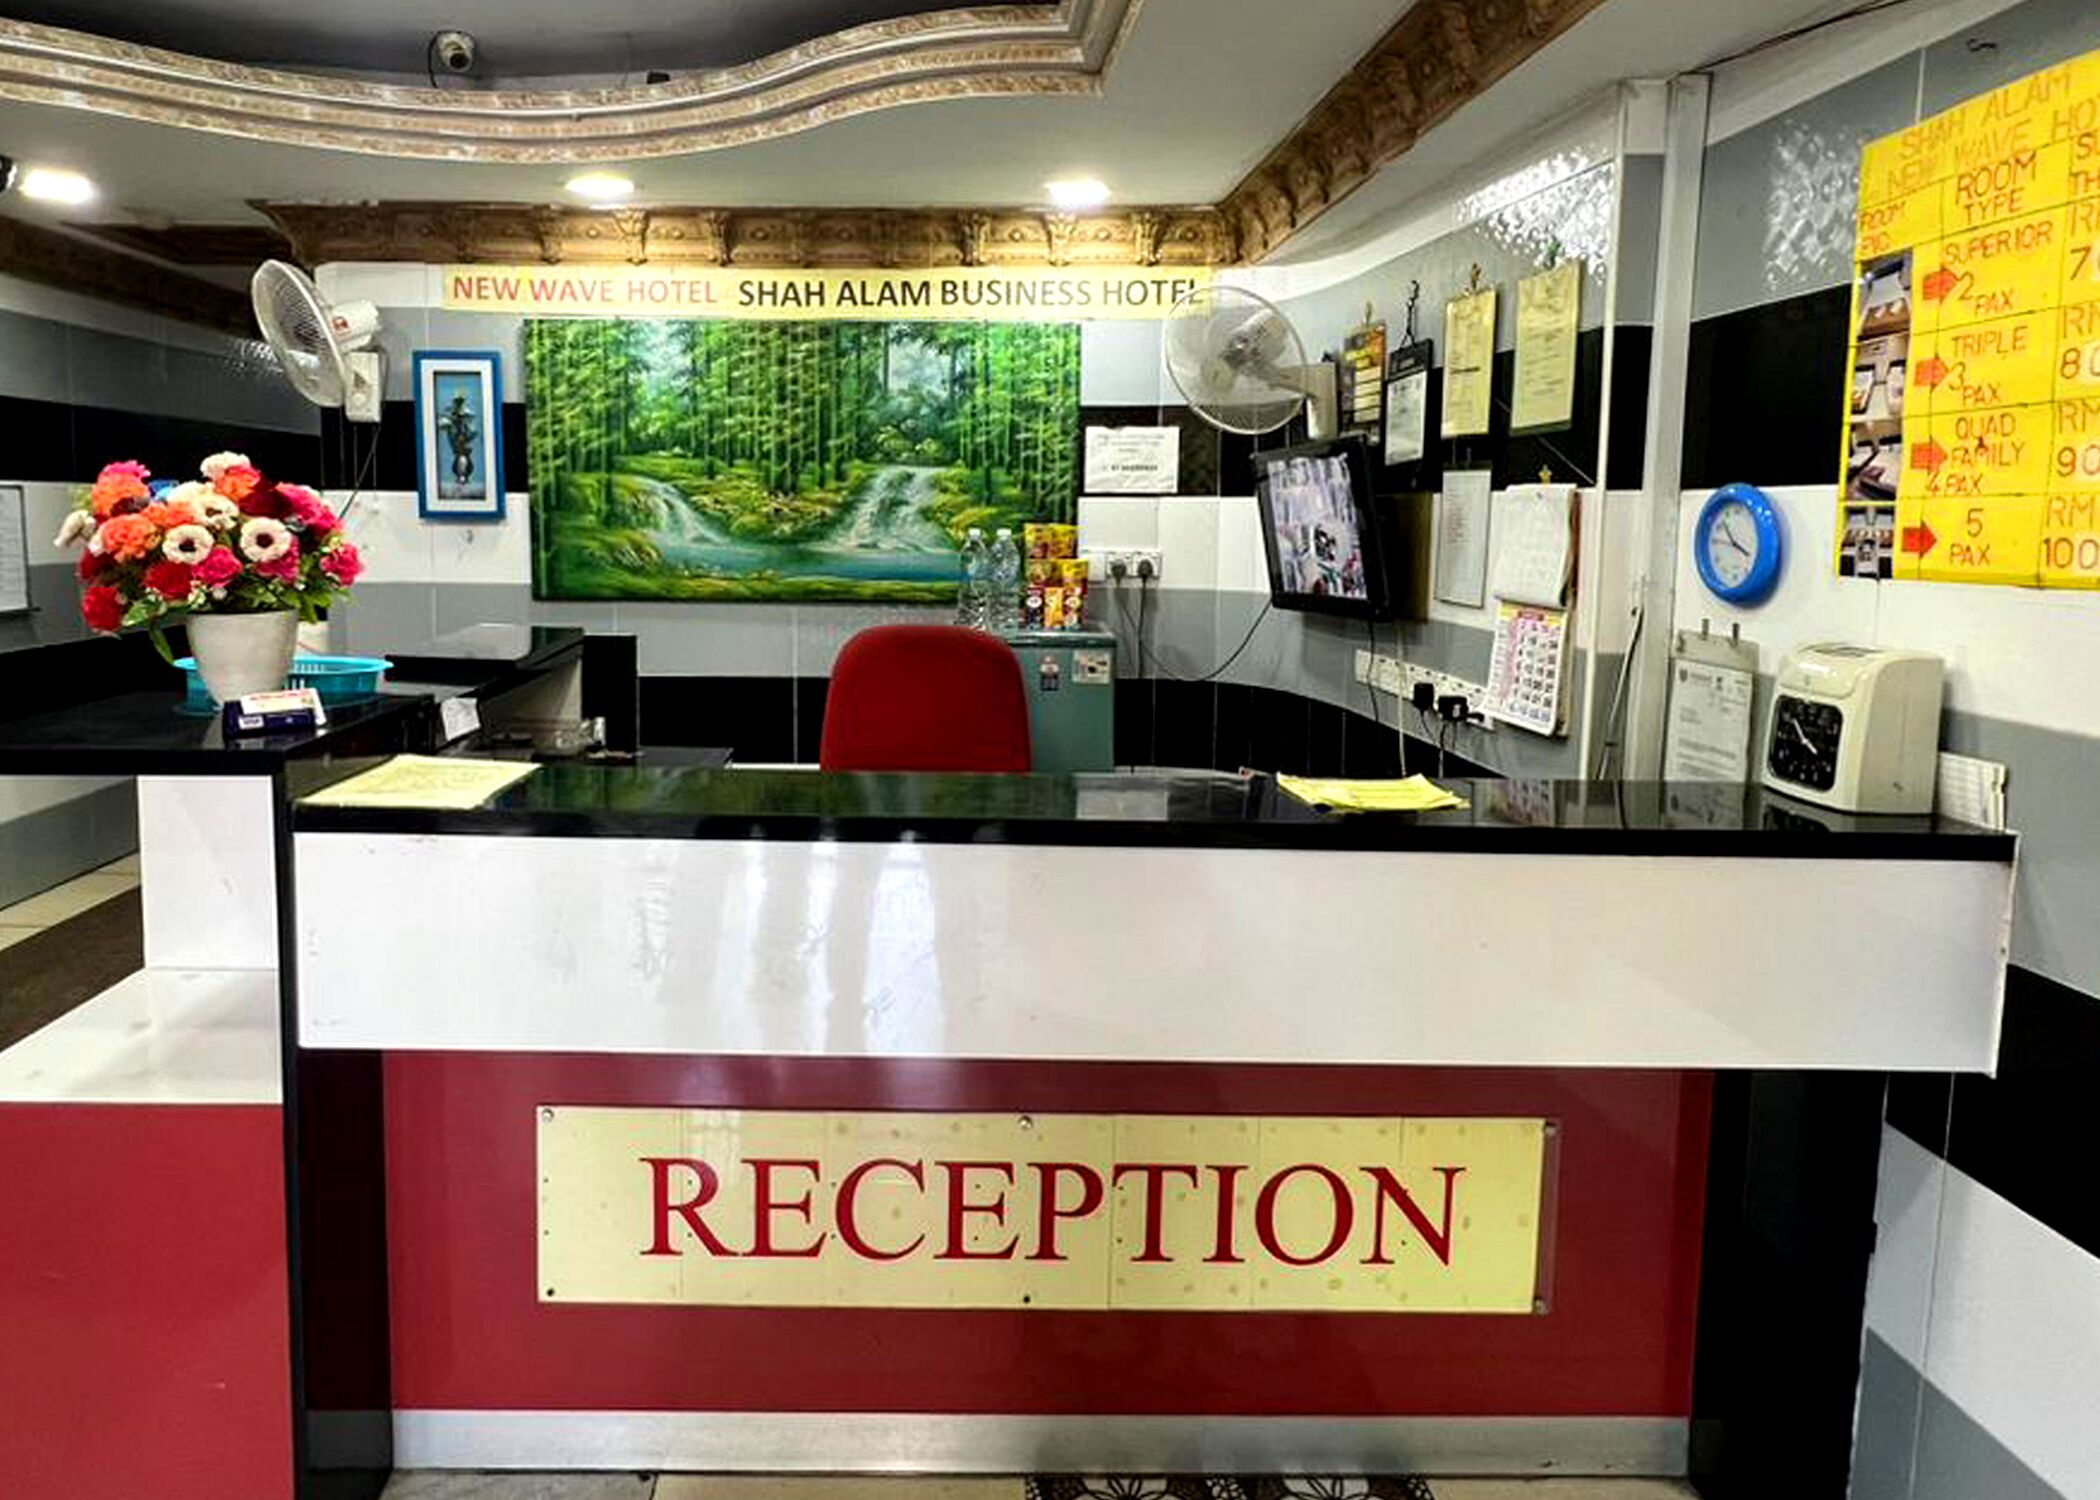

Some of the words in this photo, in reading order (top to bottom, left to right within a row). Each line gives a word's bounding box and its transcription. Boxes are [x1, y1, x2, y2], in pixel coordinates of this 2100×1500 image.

[1980, 72, 2071, 126] ALAM
[2051, 94, 2100, 143] HO
[1955, 149, 2037, 205] ROOM
[1963, 188, 2026, 225] TYPE
[1943, 220, 2054, 265] SUPERIOR
[453, 276, 520, 300] NEW
[530, 279, 613, 302] WAVE
[628, 280, 718, 303] HOTEL
[738, 280, 825, 307] SHAH
[835, 280, 931, 307] ALAM
[941, 280, 1091, 306] BUSINESS
[1103, 279, 1204, 306] HOTEL
[1958, 271, 1975, 301] 2
[1974, 289, 2015, 316] PAX
[1951, 325, 2028, 360] TRIPLE
[1948, 361, 1966, 392] 3
[1962, 382, 2003, 408] PAX
[1955, 412, 2016, 440] QUAD
[1950, 440, 2025, 469] FAMILY
[2056, 444, 2100, 478] 90
[1945, 473, 1984, 496] PAX
[1966, 507, 1985, 538] 5
[2046, 494, 2095, 528] RM
[1950, 543, 1991, 566] PAX
[2043, 536, 2099, 570] 100
[638, 1155, 1466, 1267] RECEPTION
